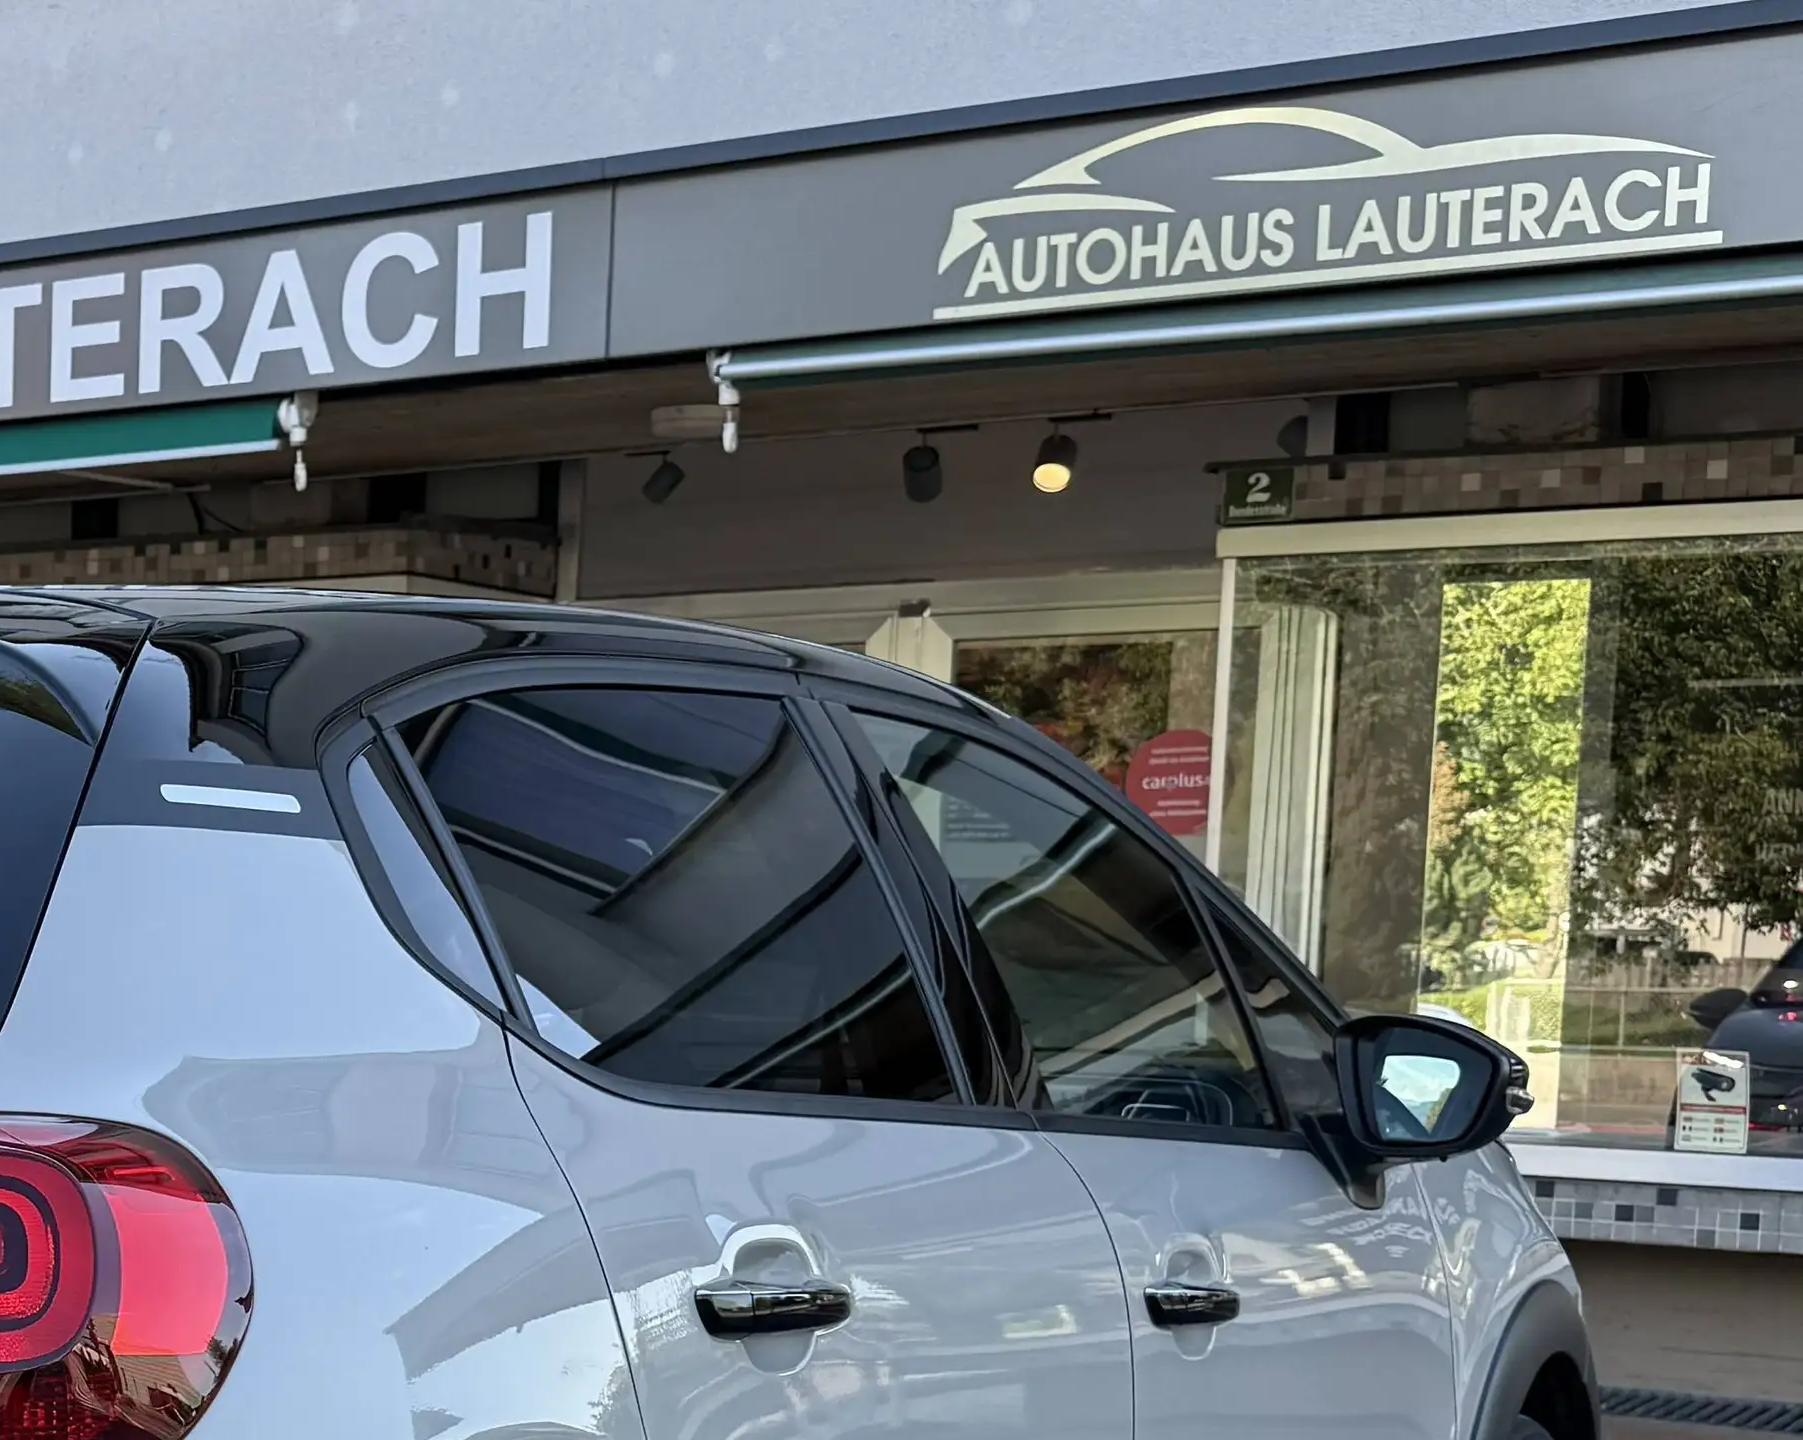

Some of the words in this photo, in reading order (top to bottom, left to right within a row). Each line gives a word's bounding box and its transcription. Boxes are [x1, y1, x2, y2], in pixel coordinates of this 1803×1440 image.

[964, 208, 1294, 298] AUTOHAUS
[1316, 163, 1711, 261] LAUTERACH
[1246, 472, 1271, 502] 2
